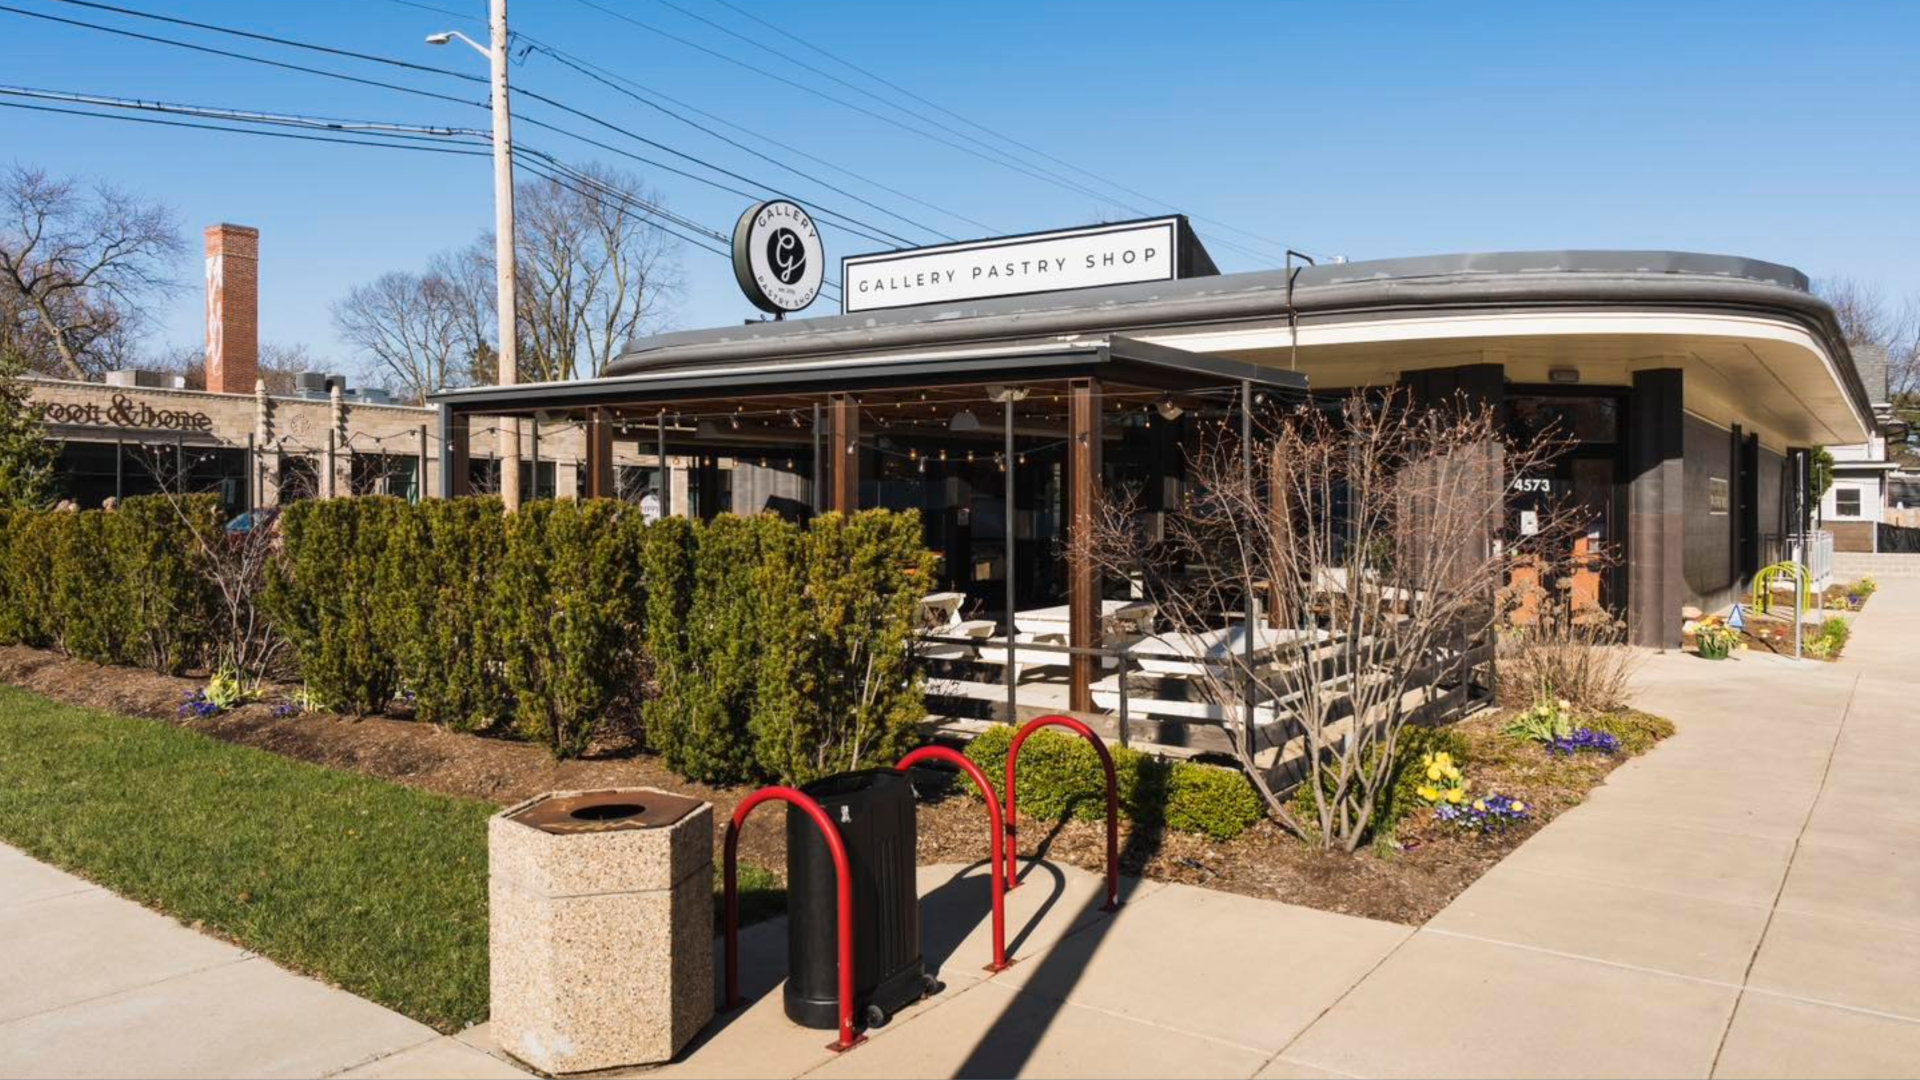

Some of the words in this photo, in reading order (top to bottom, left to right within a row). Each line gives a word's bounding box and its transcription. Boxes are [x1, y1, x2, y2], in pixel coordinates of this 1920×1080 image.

[758, 205, 816, 238] GALLERY
[858, 269, 956, 293] GALLERY
[972, 257, 1067, 280] PASTRY
[1085, 247, 1157, 269] SHOP
[758, 275, 790, 306] PASTRY
[793, 286, 815, 307] SHOP
[1513, 478, 1550, 492] 4573
